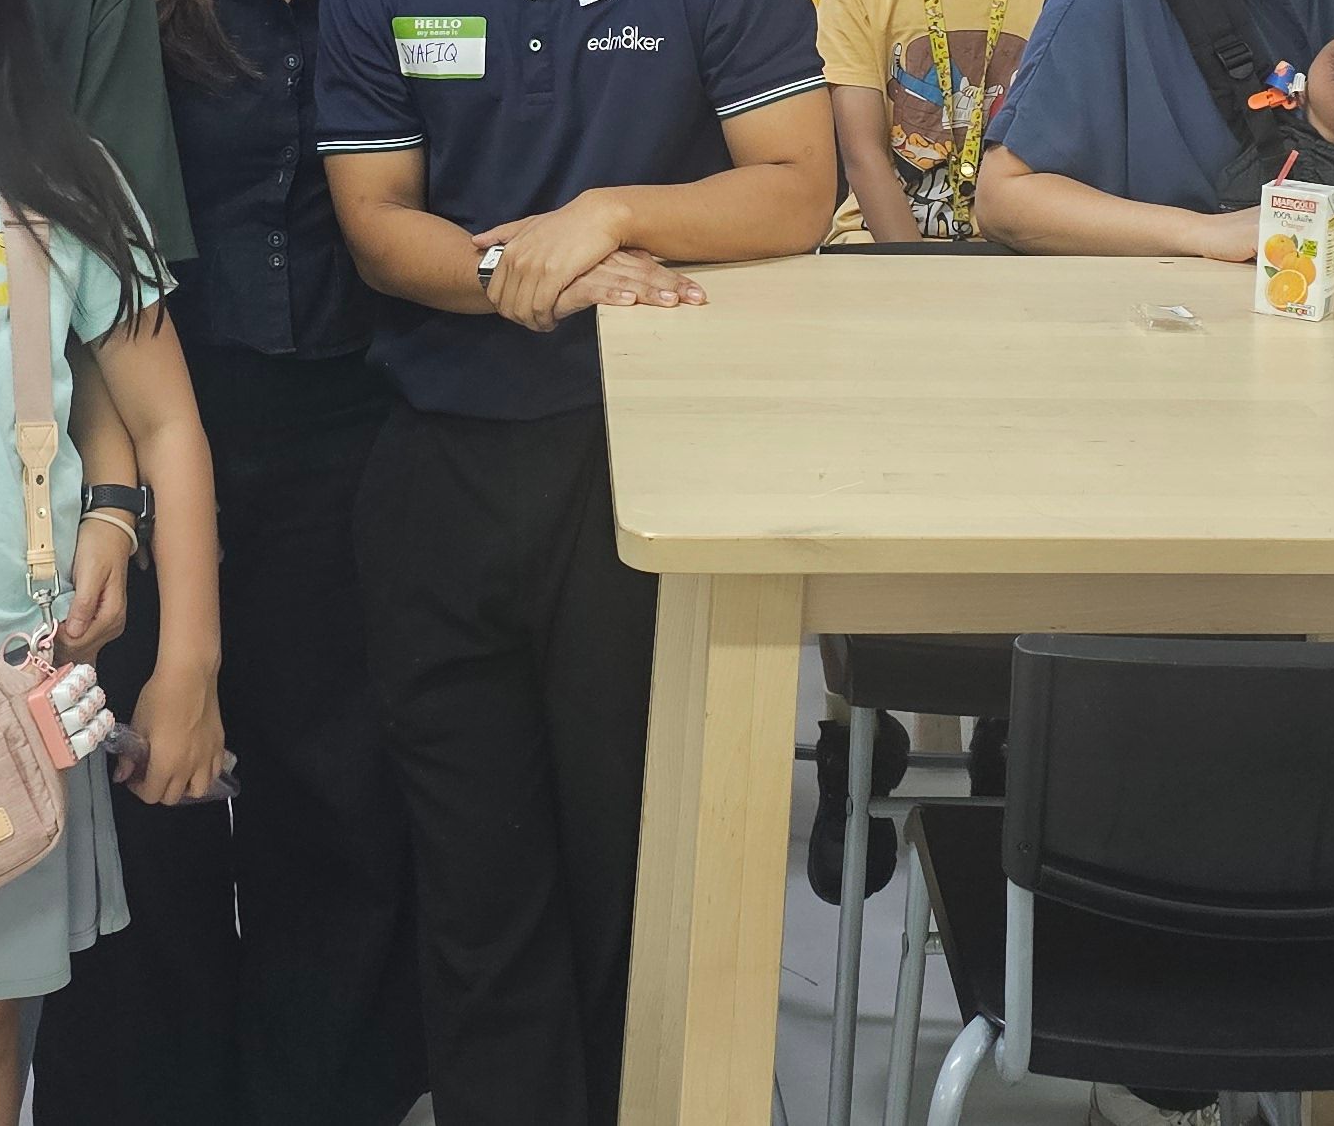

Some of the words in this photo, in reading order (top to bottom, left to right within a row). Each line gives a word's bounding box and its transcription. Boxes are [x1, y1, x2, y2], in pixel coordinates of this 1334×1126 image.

[414, 18, 462, 29] HELLO
[416, 30, 428, 38] my
[400, 42, 458, 65] SYAFIQ
